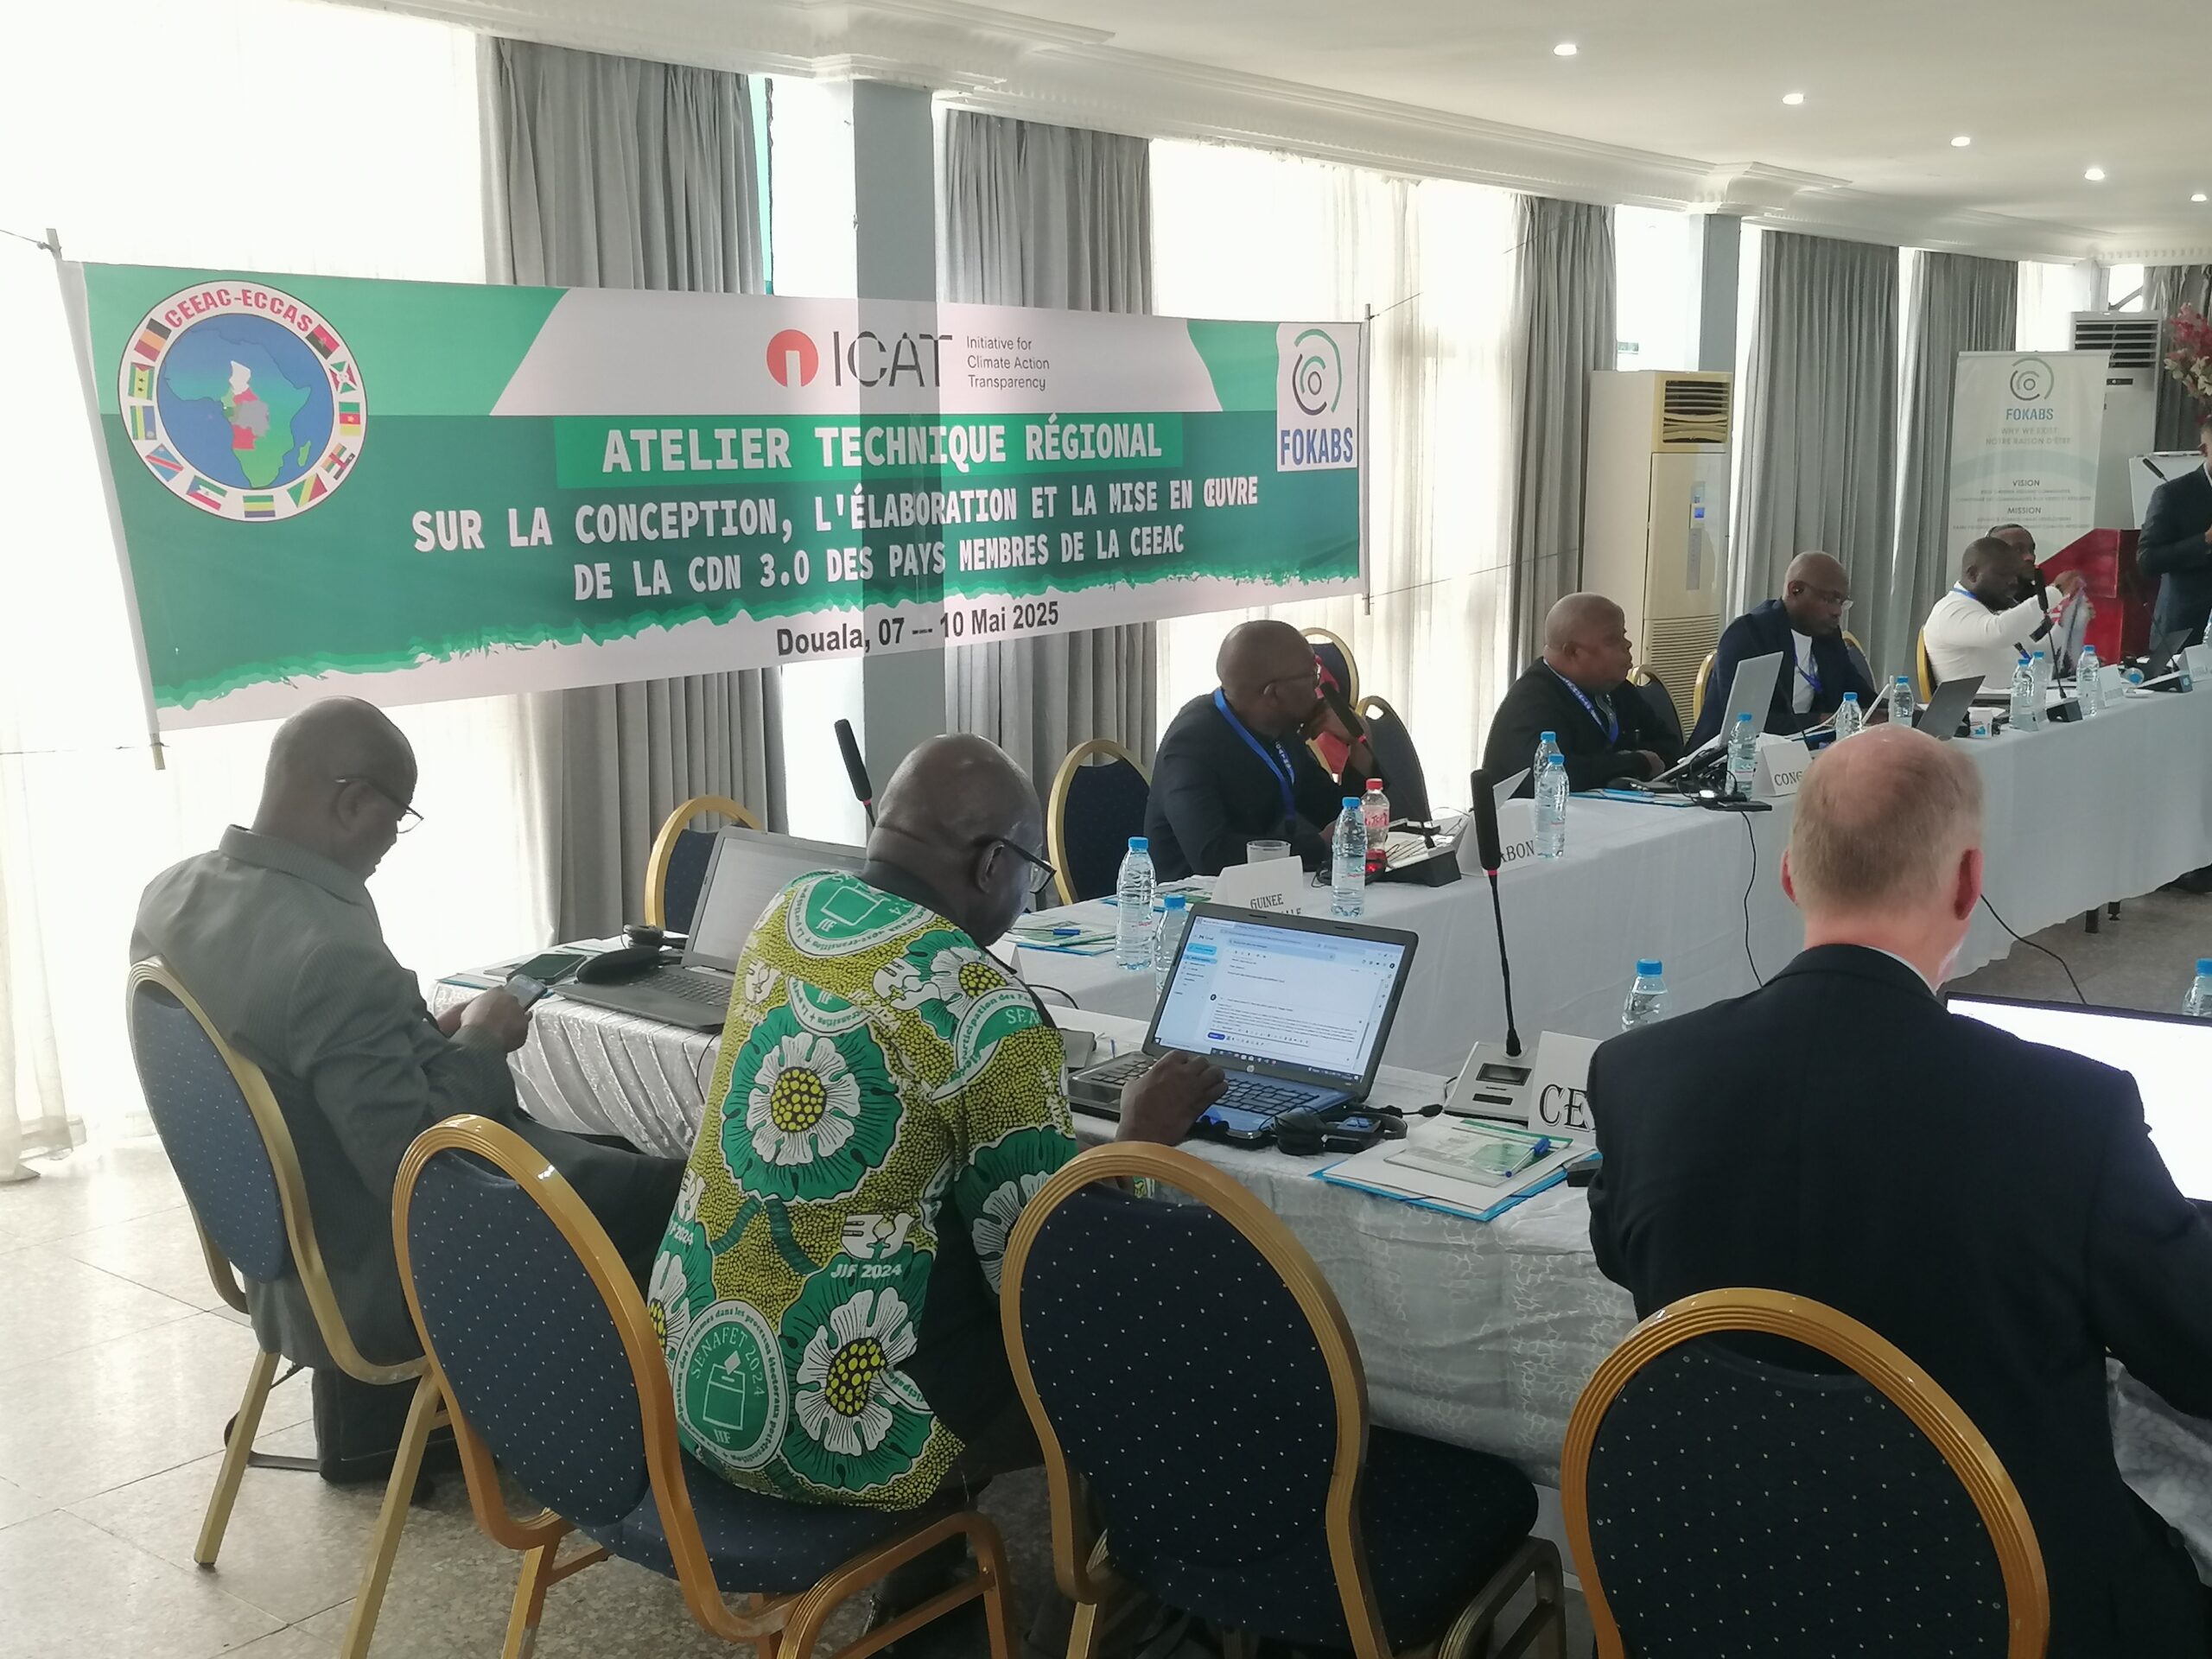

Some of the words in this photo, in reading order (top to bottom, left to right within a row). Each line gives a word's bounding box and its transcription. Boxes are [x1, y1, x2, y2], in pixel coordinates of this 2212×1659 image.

[164, 289, 313, 332] CEEAC-ECCAS
[833, 330, 953, 387] ICAT
[966, 335, 1014, 351] Initiative
[1017, 335, 1032, 351] for
[967, 354, 1011, 369] Climate
[1014, 356, 1050, 371] Action
[968, 373, 1046, 391] Transparency
[2005, 408, 2054, 421] FOKABS
[601, 427, 792, 474] ATELIER
[814, 424, 1007, 474] TECHNIQUE
[1025, 411, 1162, 461] RÉGIONAL
[1280, 426, 1354, 467] FOKABS
[411, 509, 486, 553] SUR
[507, 506, 553, 548] LA
[575, 498, 793, 544] CONCEPTION,
[814, 482, 1017, 532] L'ÉLABORATION
[1031, 486, 1058, 519] ET
[1071, 484, 1097, 517] LA
[1109, 481, 1158, 514] MISE
[1169, 479, 1193, 510] EN
[1203, 476, 1259, 508] ŒUVRE
[573, 562, 613, 601] DE
[632, 559, 672, 596] LA
[688, 554, 741, 593] CDN
[759, 549, 810, 588] 3.0
[826, 546, 874, 582] DES
[888, 541, 946, 578] PAYS
[958, 533, 1050, 572] MEMBRES
[1060, 531, 1084, 563] DE
[1096, 528, 1121, 560] LA
[1129, 523, 1185, 556] CEEAC
[776, 623, 871, 657] Douala,
[878, 616, 906, 645] 07
[940, 610, 964, 639] 10
[970, 607, 1007, 635] Mai
[1012, 601, 1059, 630] 2025
[1249, 893, 1284, 909] GUINEE
[1539, 1084, 1597, 1134] CE
[830, 1264, 857, 1279] JIF
[861, 1262, 904, 1280] 2024
[715, 1308, 734, 1318] dans
[691, 1326, 748, 1379] SENAFET
[745, 1344, 766, 1397] 2024
[714, 1428, 732, 1445] JIF
